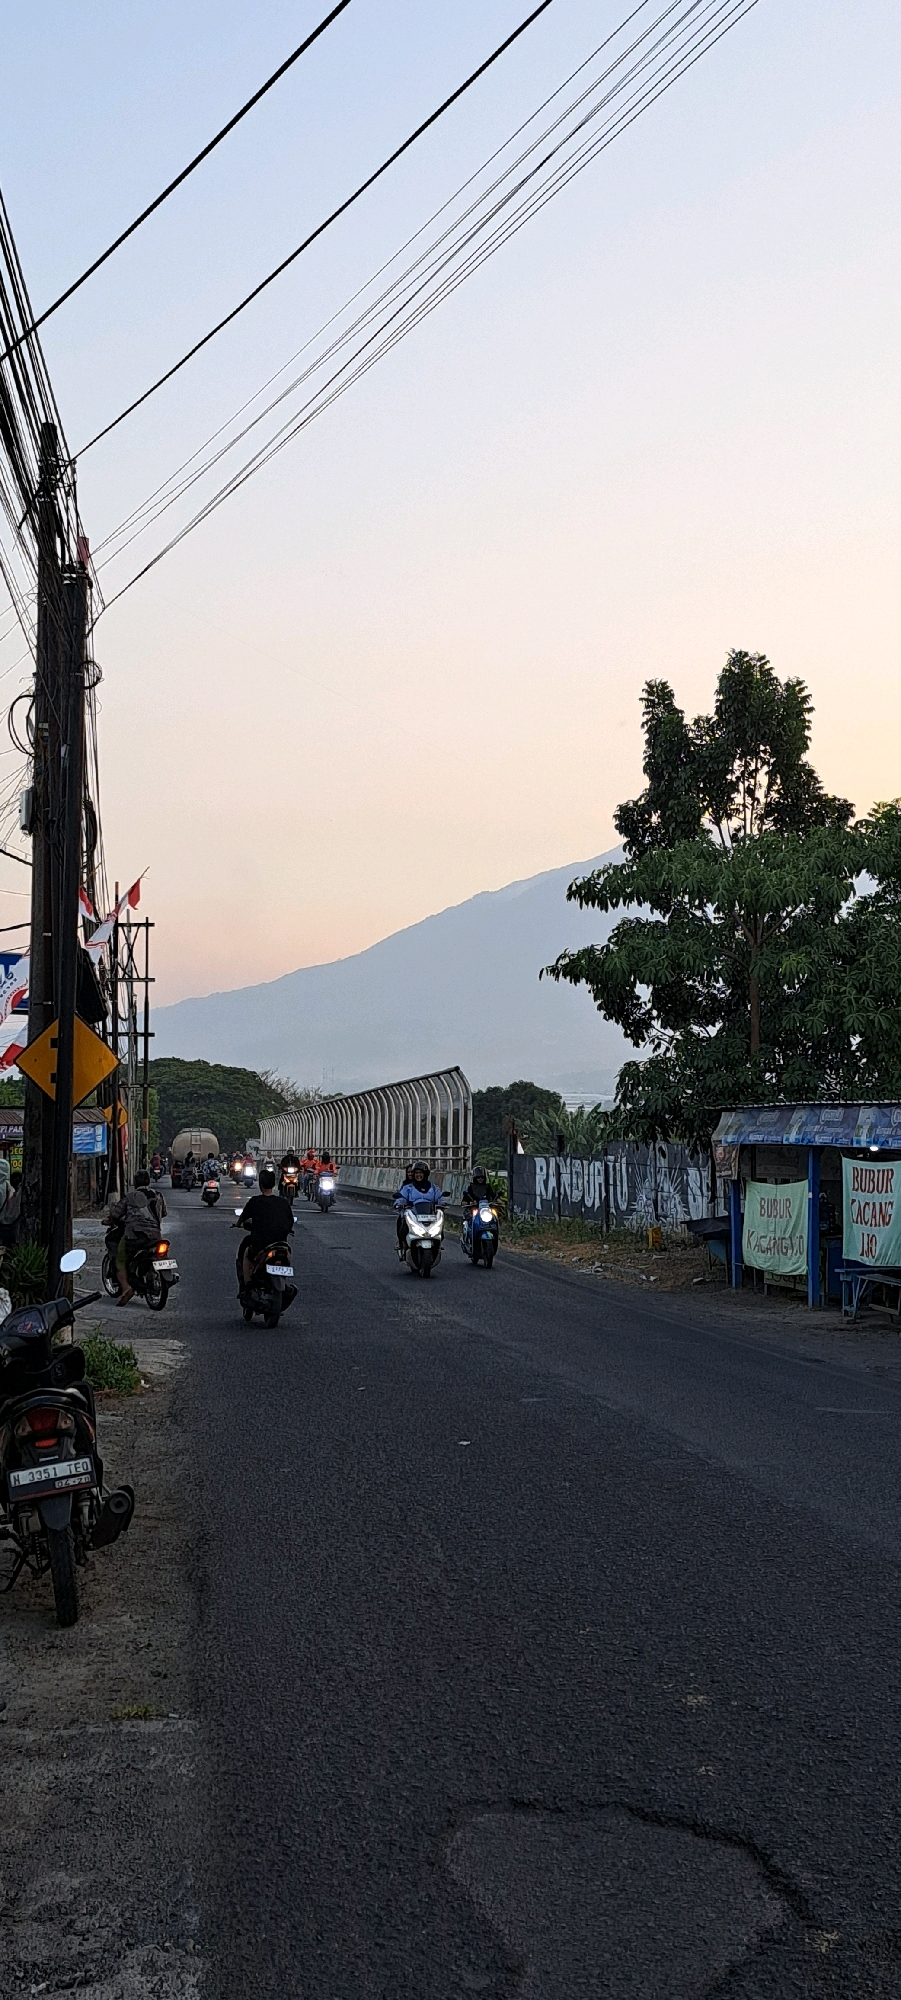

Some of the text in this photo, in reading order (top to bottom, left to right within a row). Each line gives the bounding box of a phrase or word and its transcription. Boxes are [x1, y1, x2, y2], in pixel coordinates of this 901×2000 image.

[852, 1166, 894, 1194] BUBUR
[759, 1197, 792, 1219] BUBUR
[746, 1229, 789, 1256] KACANG
[860, 1232, 877, 1259] IJO
[12, 1473, 21, 1485] N
[28, 1467, 57, 1482] 3351
